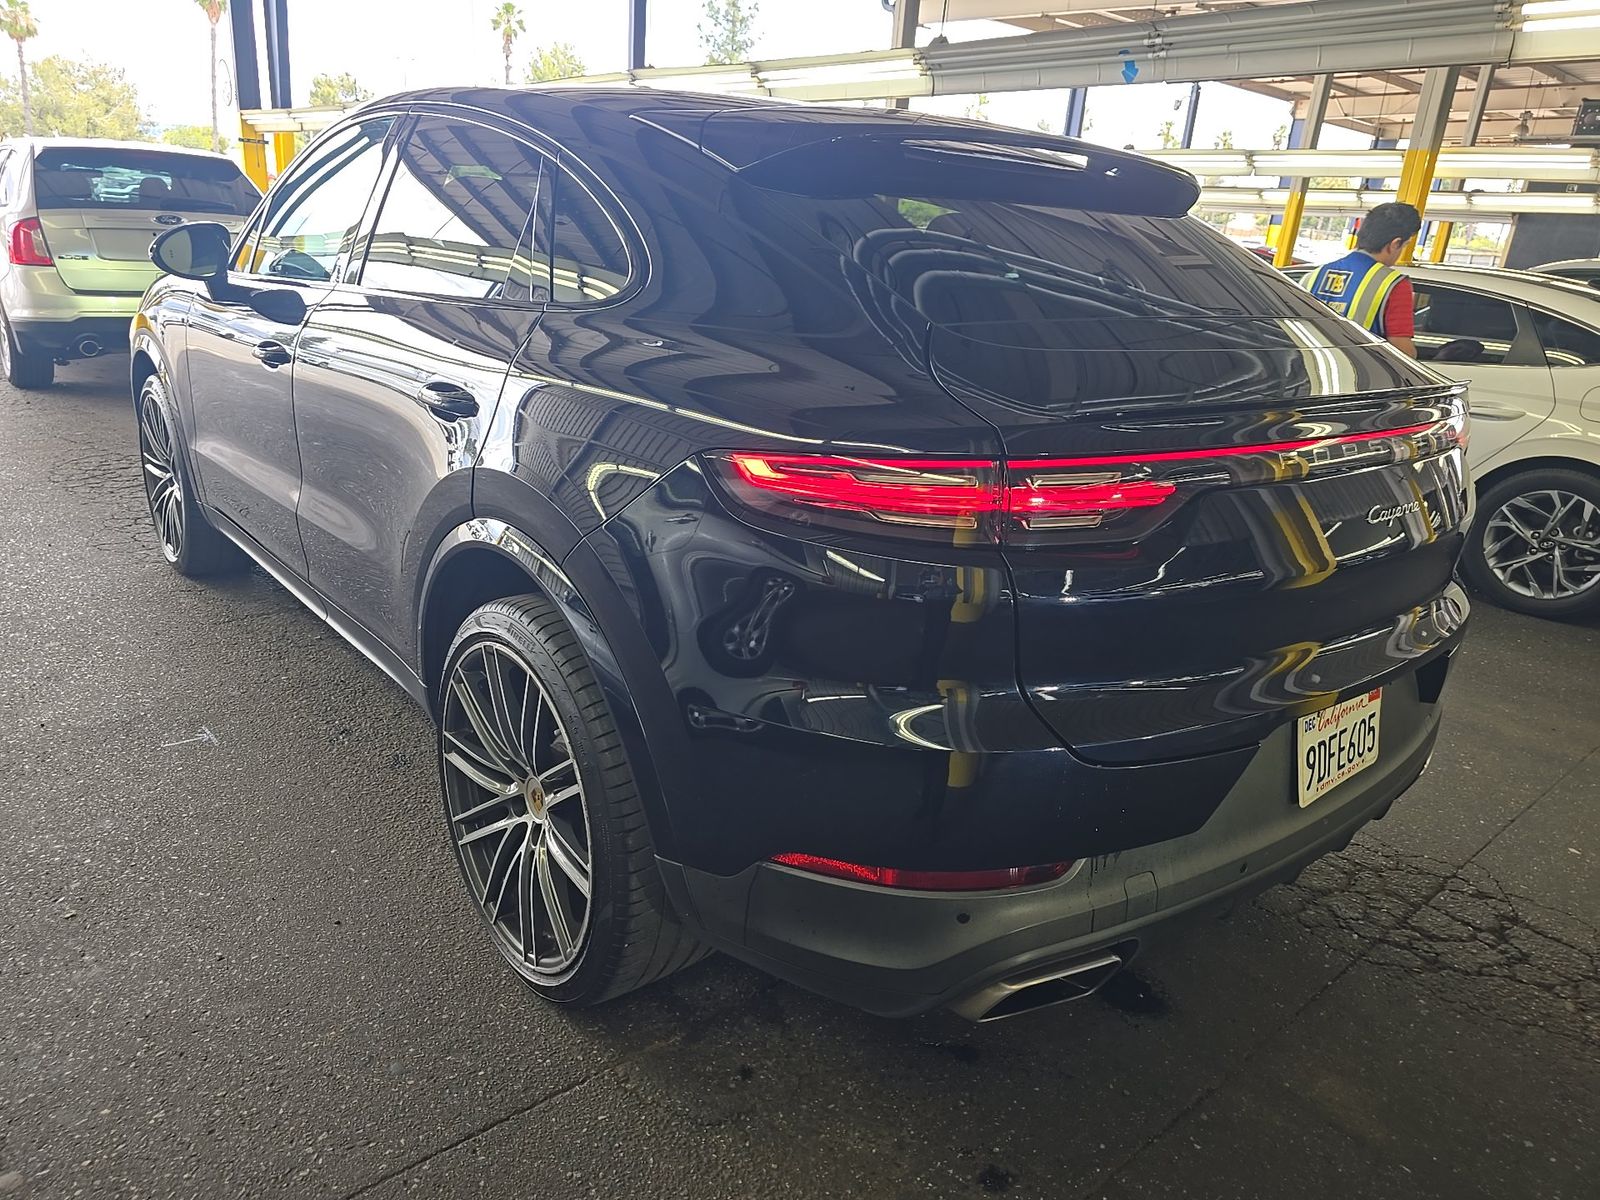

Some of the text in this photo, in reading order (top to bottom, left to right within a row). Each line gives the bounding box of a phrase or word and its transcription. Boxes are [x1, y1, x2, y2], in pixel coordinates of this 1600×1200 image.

[1365, 501, 1421, 527] Cayenne
[1304, 716, 1316, 733] DEC
[1318, 698, 1368, 732] California
[1306, 711, 1376, 791] 9DFE605
